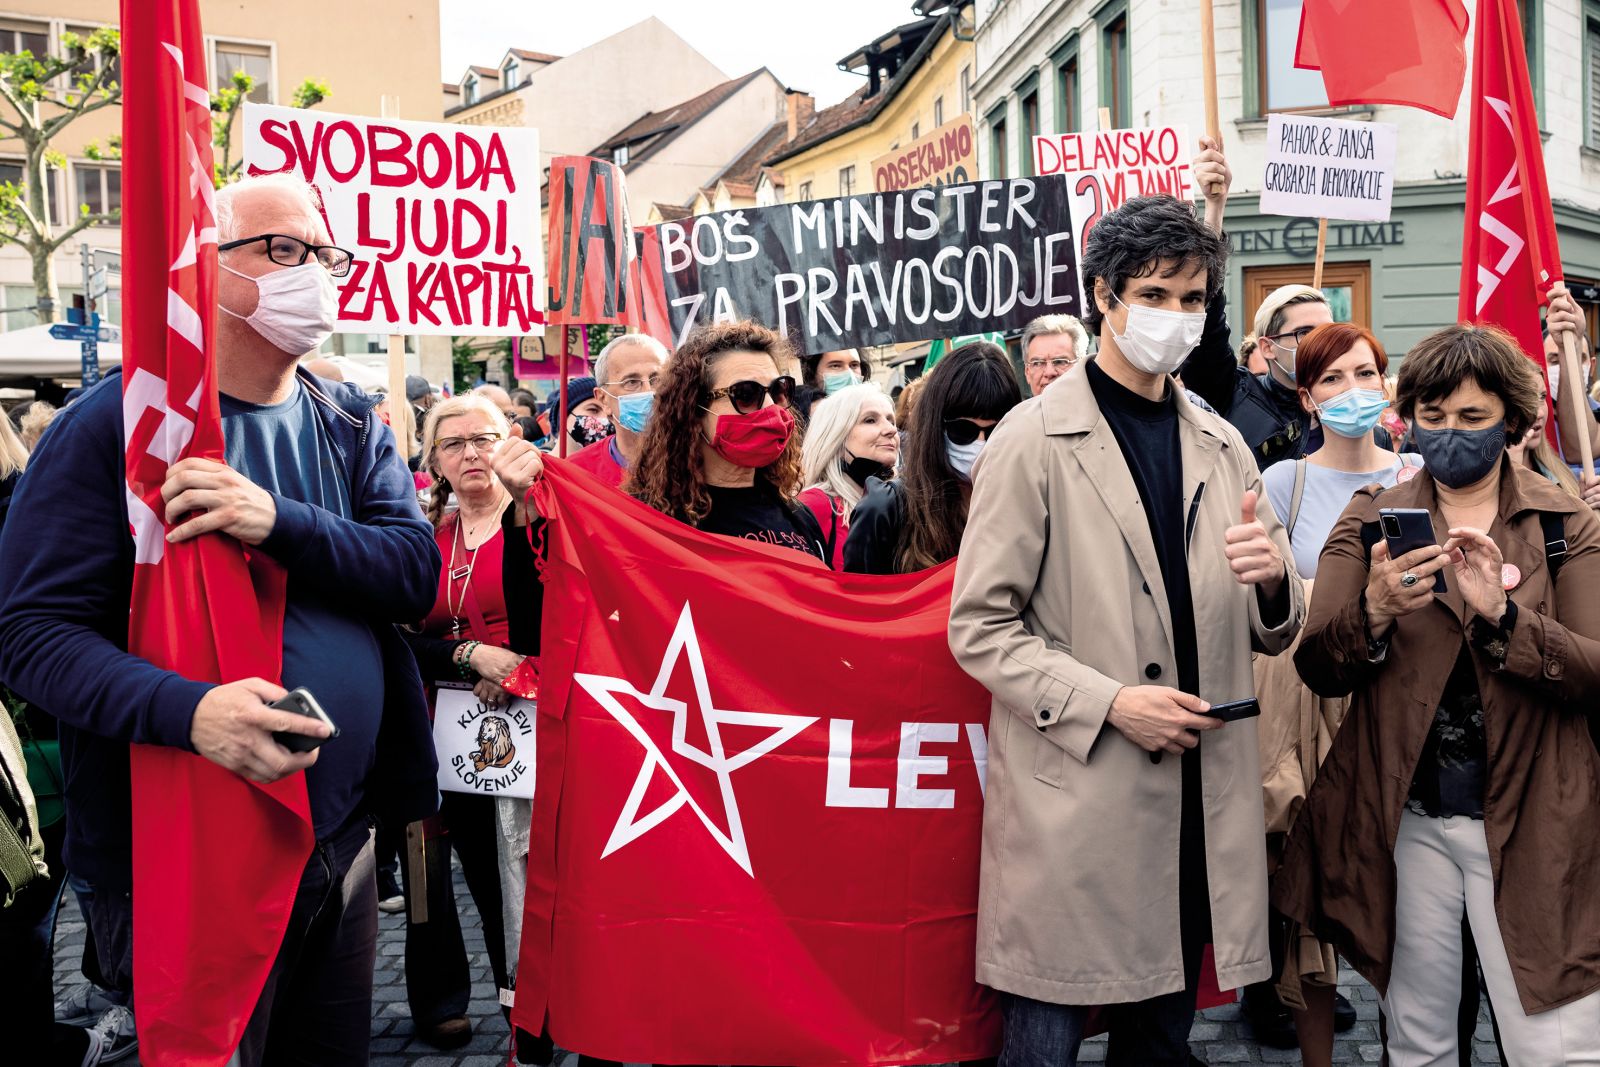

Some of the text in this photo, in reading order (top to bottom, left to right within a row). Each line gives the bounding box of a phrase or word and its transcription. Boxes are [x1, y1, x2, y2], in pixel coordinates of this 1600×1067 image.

[247, 118, 516, 194] SVOBODA
[876, 124, 972, 192] ODSEKAJMO
[1037, 127, 1179, 176] DELAVSKO
[1280, 123, 1375, 160] PAHOR & JANŠA
[1265, 162, 1385, 201] GROBARJA DEMOKRACIJE
[357, 192, 522, 265] LJUDI,
[660, 178, 1037, 273] BOŠ MINISTER
[1328, 222, 1405, 247] TIME
[407, 261, 546, 333] KAPITAL
[774, 231, 1073, 340] PRAVOSODJE
[504, 703, 532, 736] LEVI
[451, 754, 527, 792] SLOVENIJE
